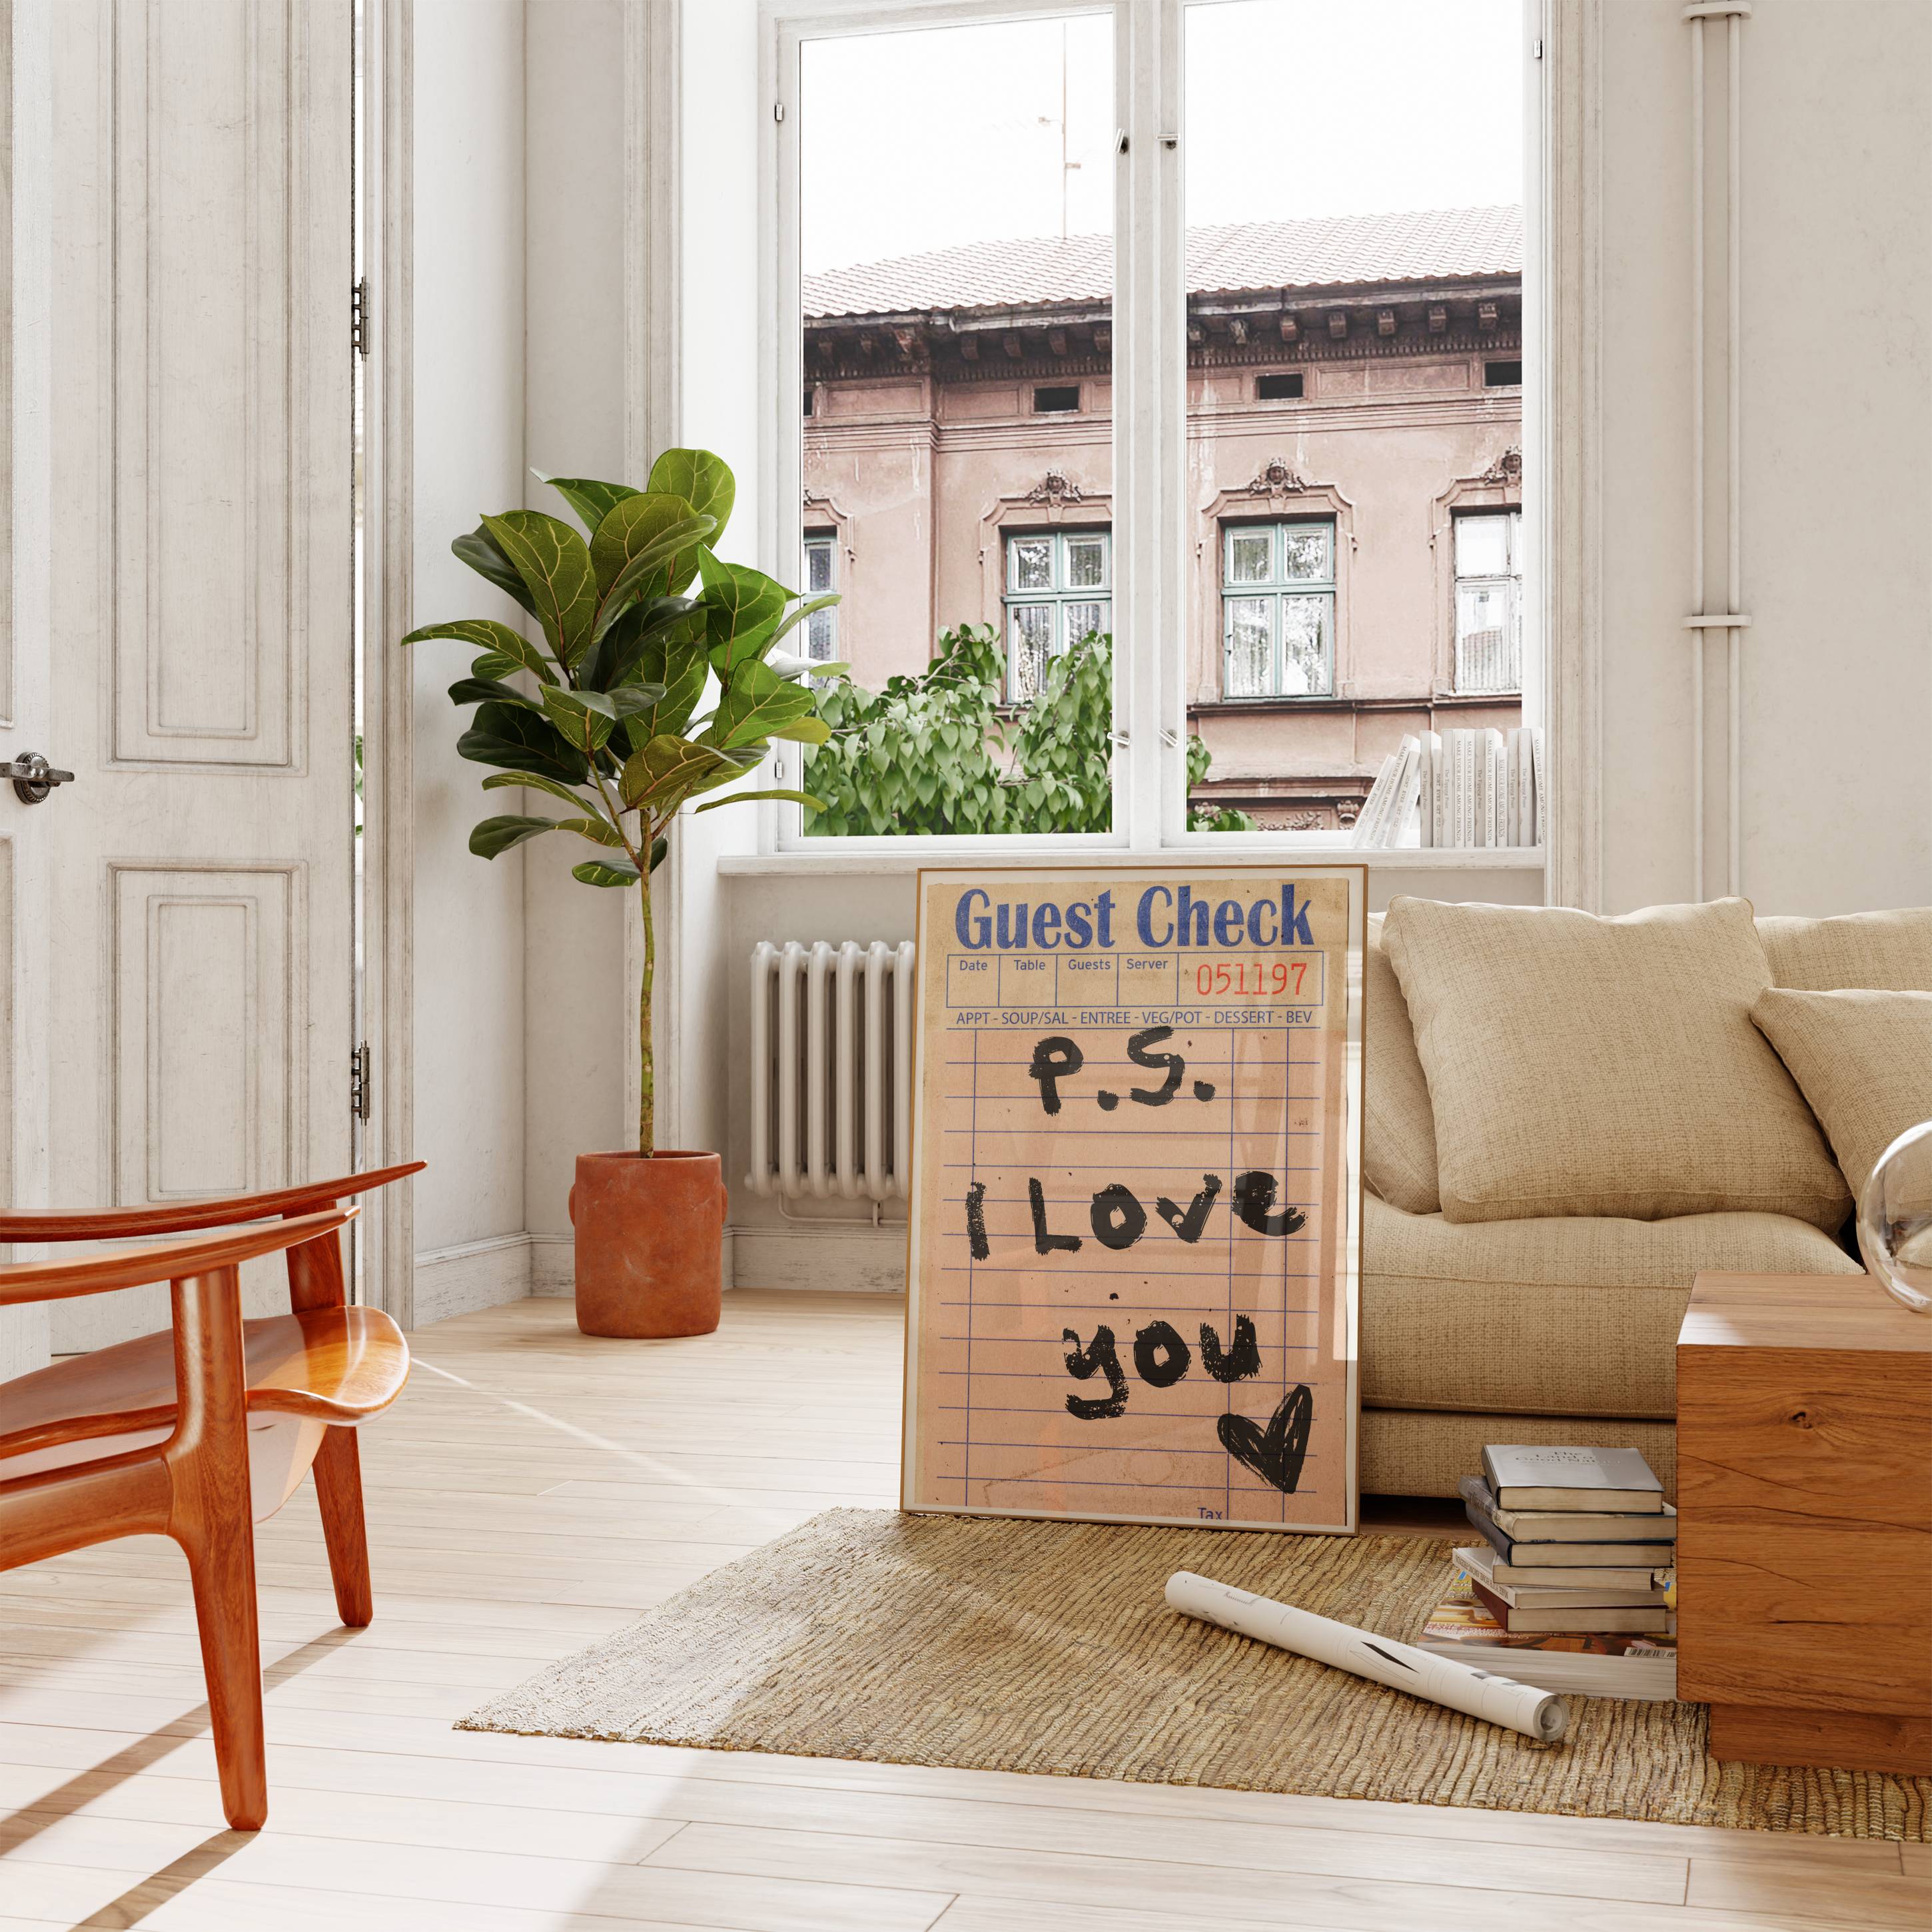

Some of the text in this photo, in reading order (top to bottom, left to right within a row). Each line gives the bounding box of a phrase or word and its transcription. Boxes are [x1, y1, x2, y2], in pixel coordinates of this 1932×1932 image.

[955, 884, 1314, 949] Guest Check
[959, 957, 1308, 996] Date Table Guests Server 051197
[956, 1012, 991, 1025] APPT
[1001, 1011, 1069, 1025] SOUP/SAL
[1081, 1011, 1131, 1025] ENTREE
[1142, 1011, 1203, 1024] VEG/POT
[1214, 1011, 1274, 1024] DESSERT
[1286, 1011, 1312, 1023] BEV
[1197, 1507, 1222, 1520] Tax
